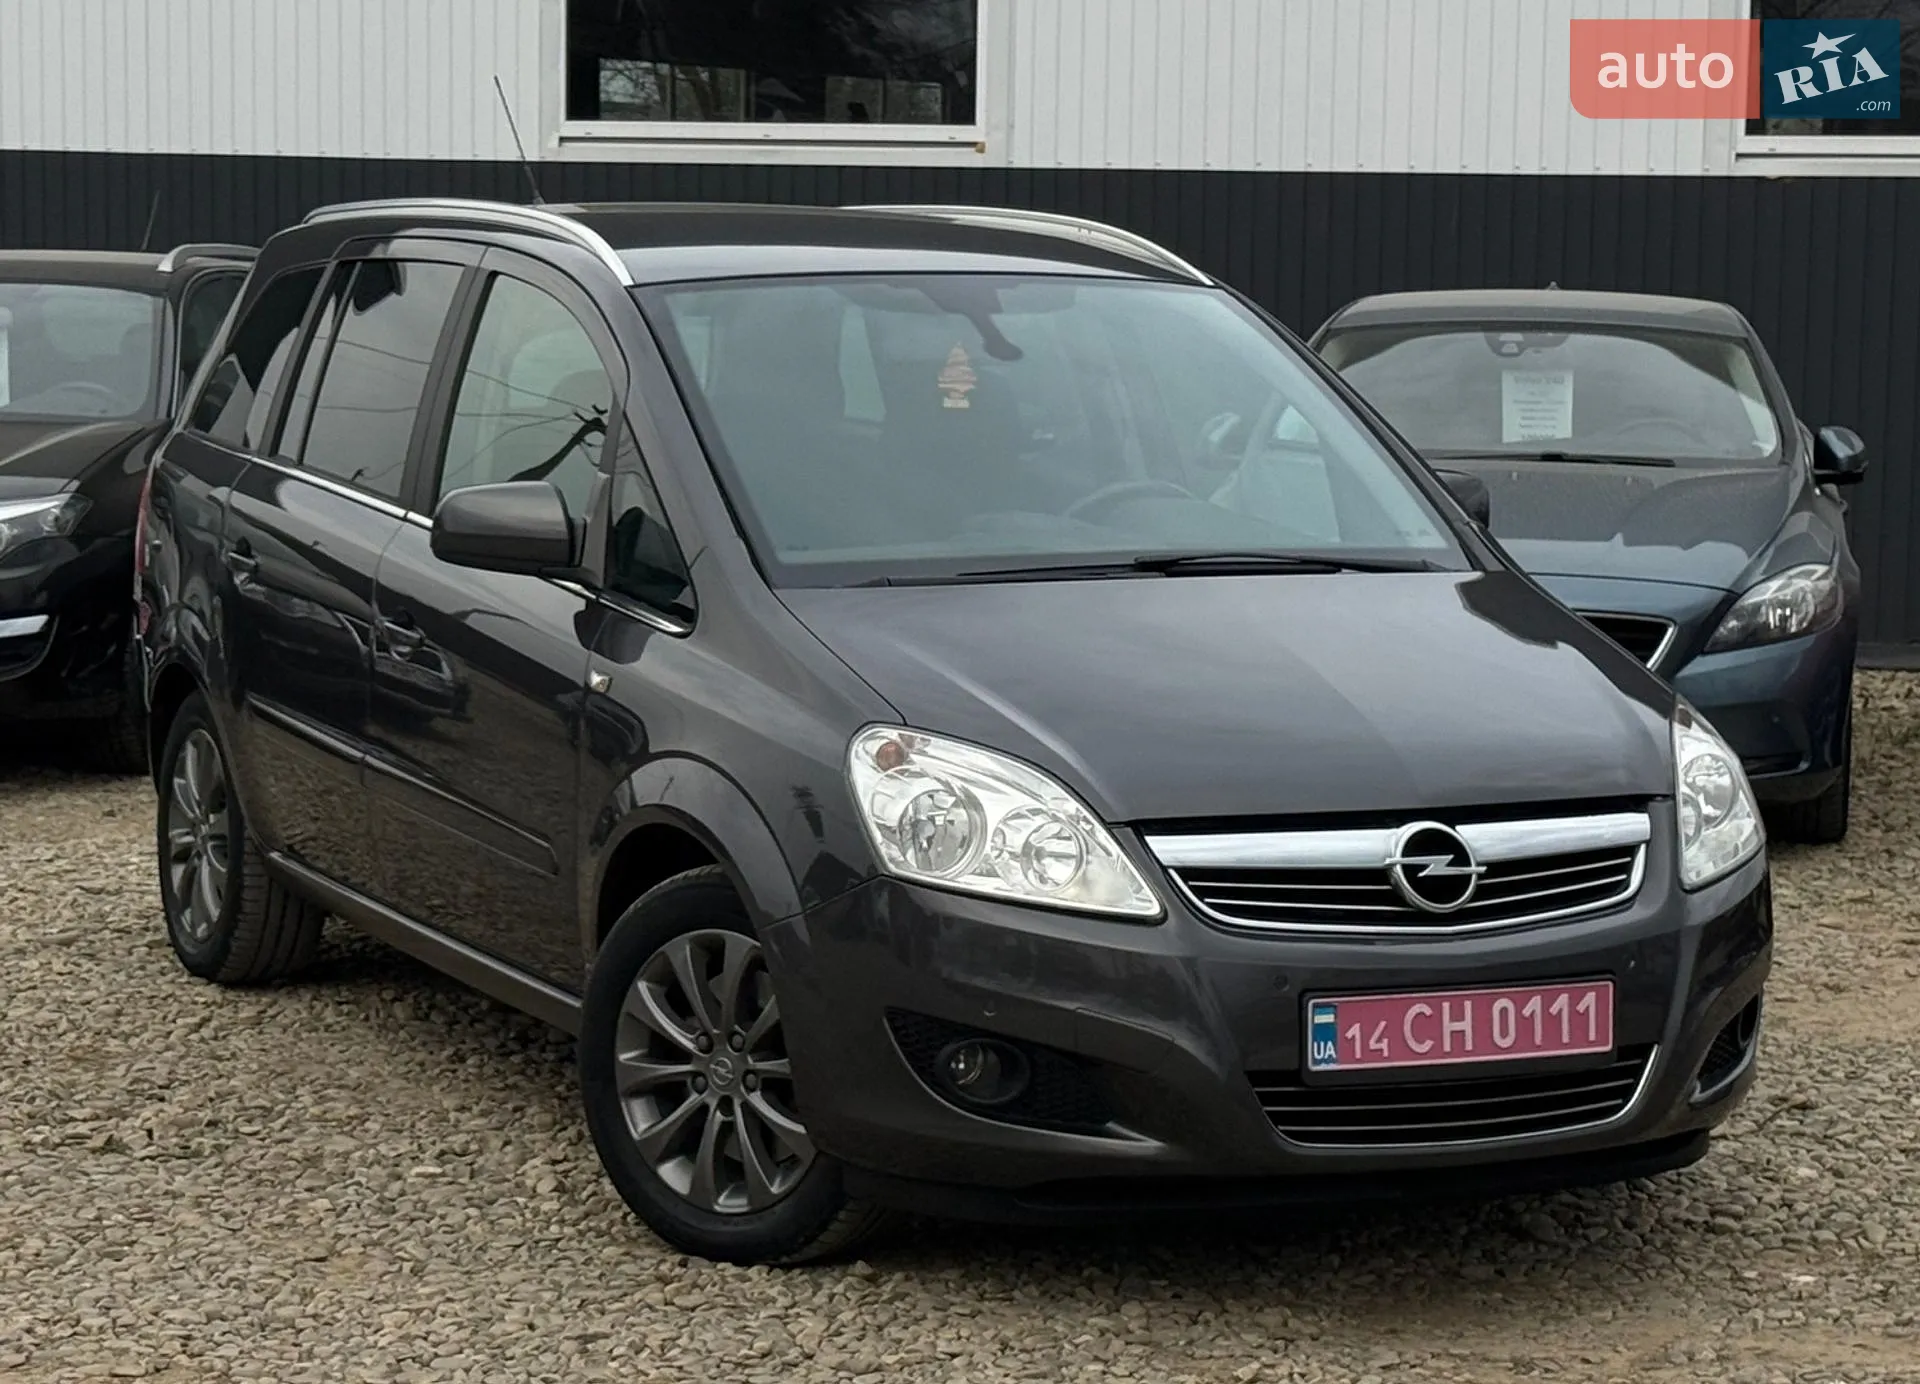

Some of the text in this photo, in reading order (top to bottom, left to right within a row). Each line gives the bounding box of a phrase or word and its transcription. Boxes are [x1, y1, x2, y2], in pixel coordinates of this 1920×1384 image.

[1345, 992, 1596, 1059] 14 CH 0111
[1313, 1042, 1336, 1059] UA
